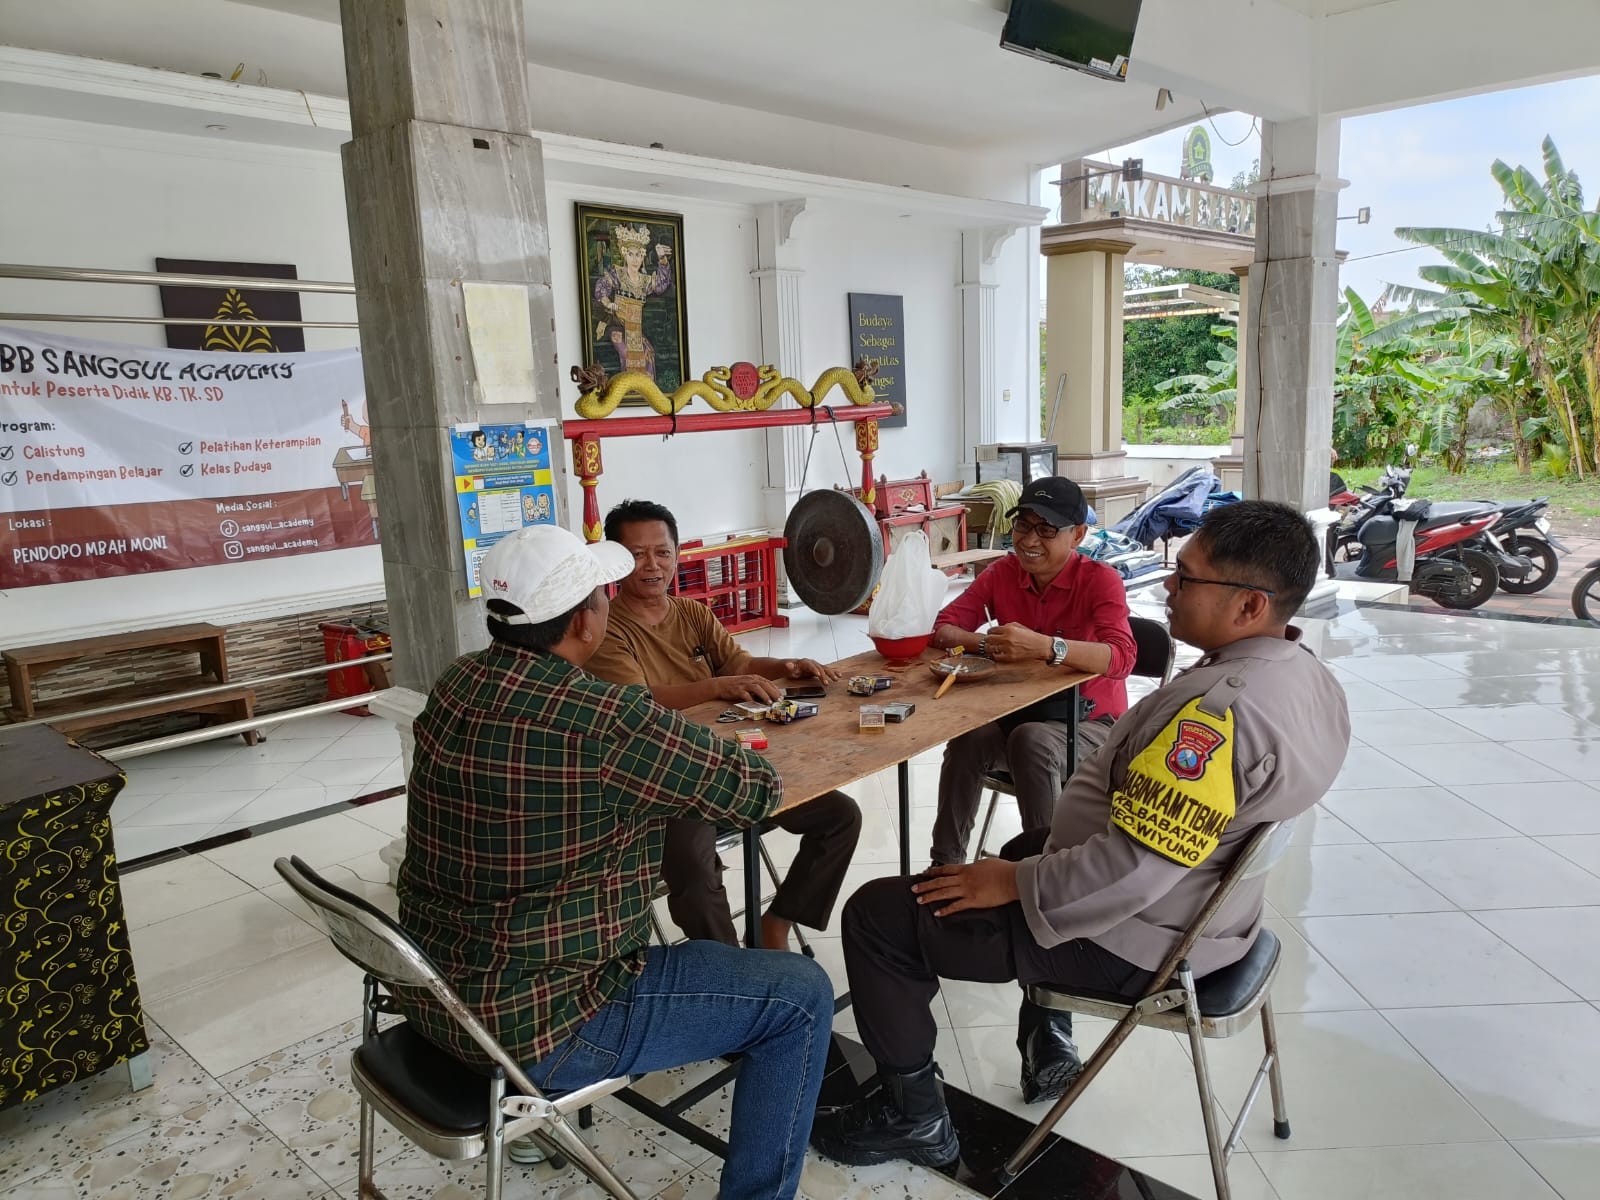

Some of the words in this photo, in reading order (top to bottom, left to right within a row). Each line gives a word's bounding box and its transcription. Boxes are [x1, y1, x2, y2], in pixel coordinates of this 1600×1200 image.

[858, 313, 893, 330] Budaya
[859, 333, 895, 350] Sebagai
[42, 348, 173, 380] SANGGUL
[179, 362, 296, 382] ACADEMY
[0, 381, 41, 397] ntuk
[46, 380, 110, 398] Peserta
[112, 384, 150, 400] Didik
[204, 386, 224, 401] SD
[0, 421, 56, 433] rogram:
[23, 444, 85, 460] Calistung
[200, 440, 251, 454] Pelatihan
[255, 436, 321, 452] Keterampilan
[26, 467, 117, 485] Pendampingan
[119, 465, 163, 480] Belajar
[201, 463, 231, 477] Kelas
[234, 461, 272, 475] Budaya
[216, 502, 244, 514] Media
[246, 500, 272, 511] Sosial
[9, 518, 45, 531] Lokasi
[242, 518, 315, 533] sanggul_academy
[13, 543, 82, 564] PENDOPO
[86, 539, 127, 556] MBAH
[131, 535, 168, 552] MONI
[246, 538, 319, 554] sanggul_academy
